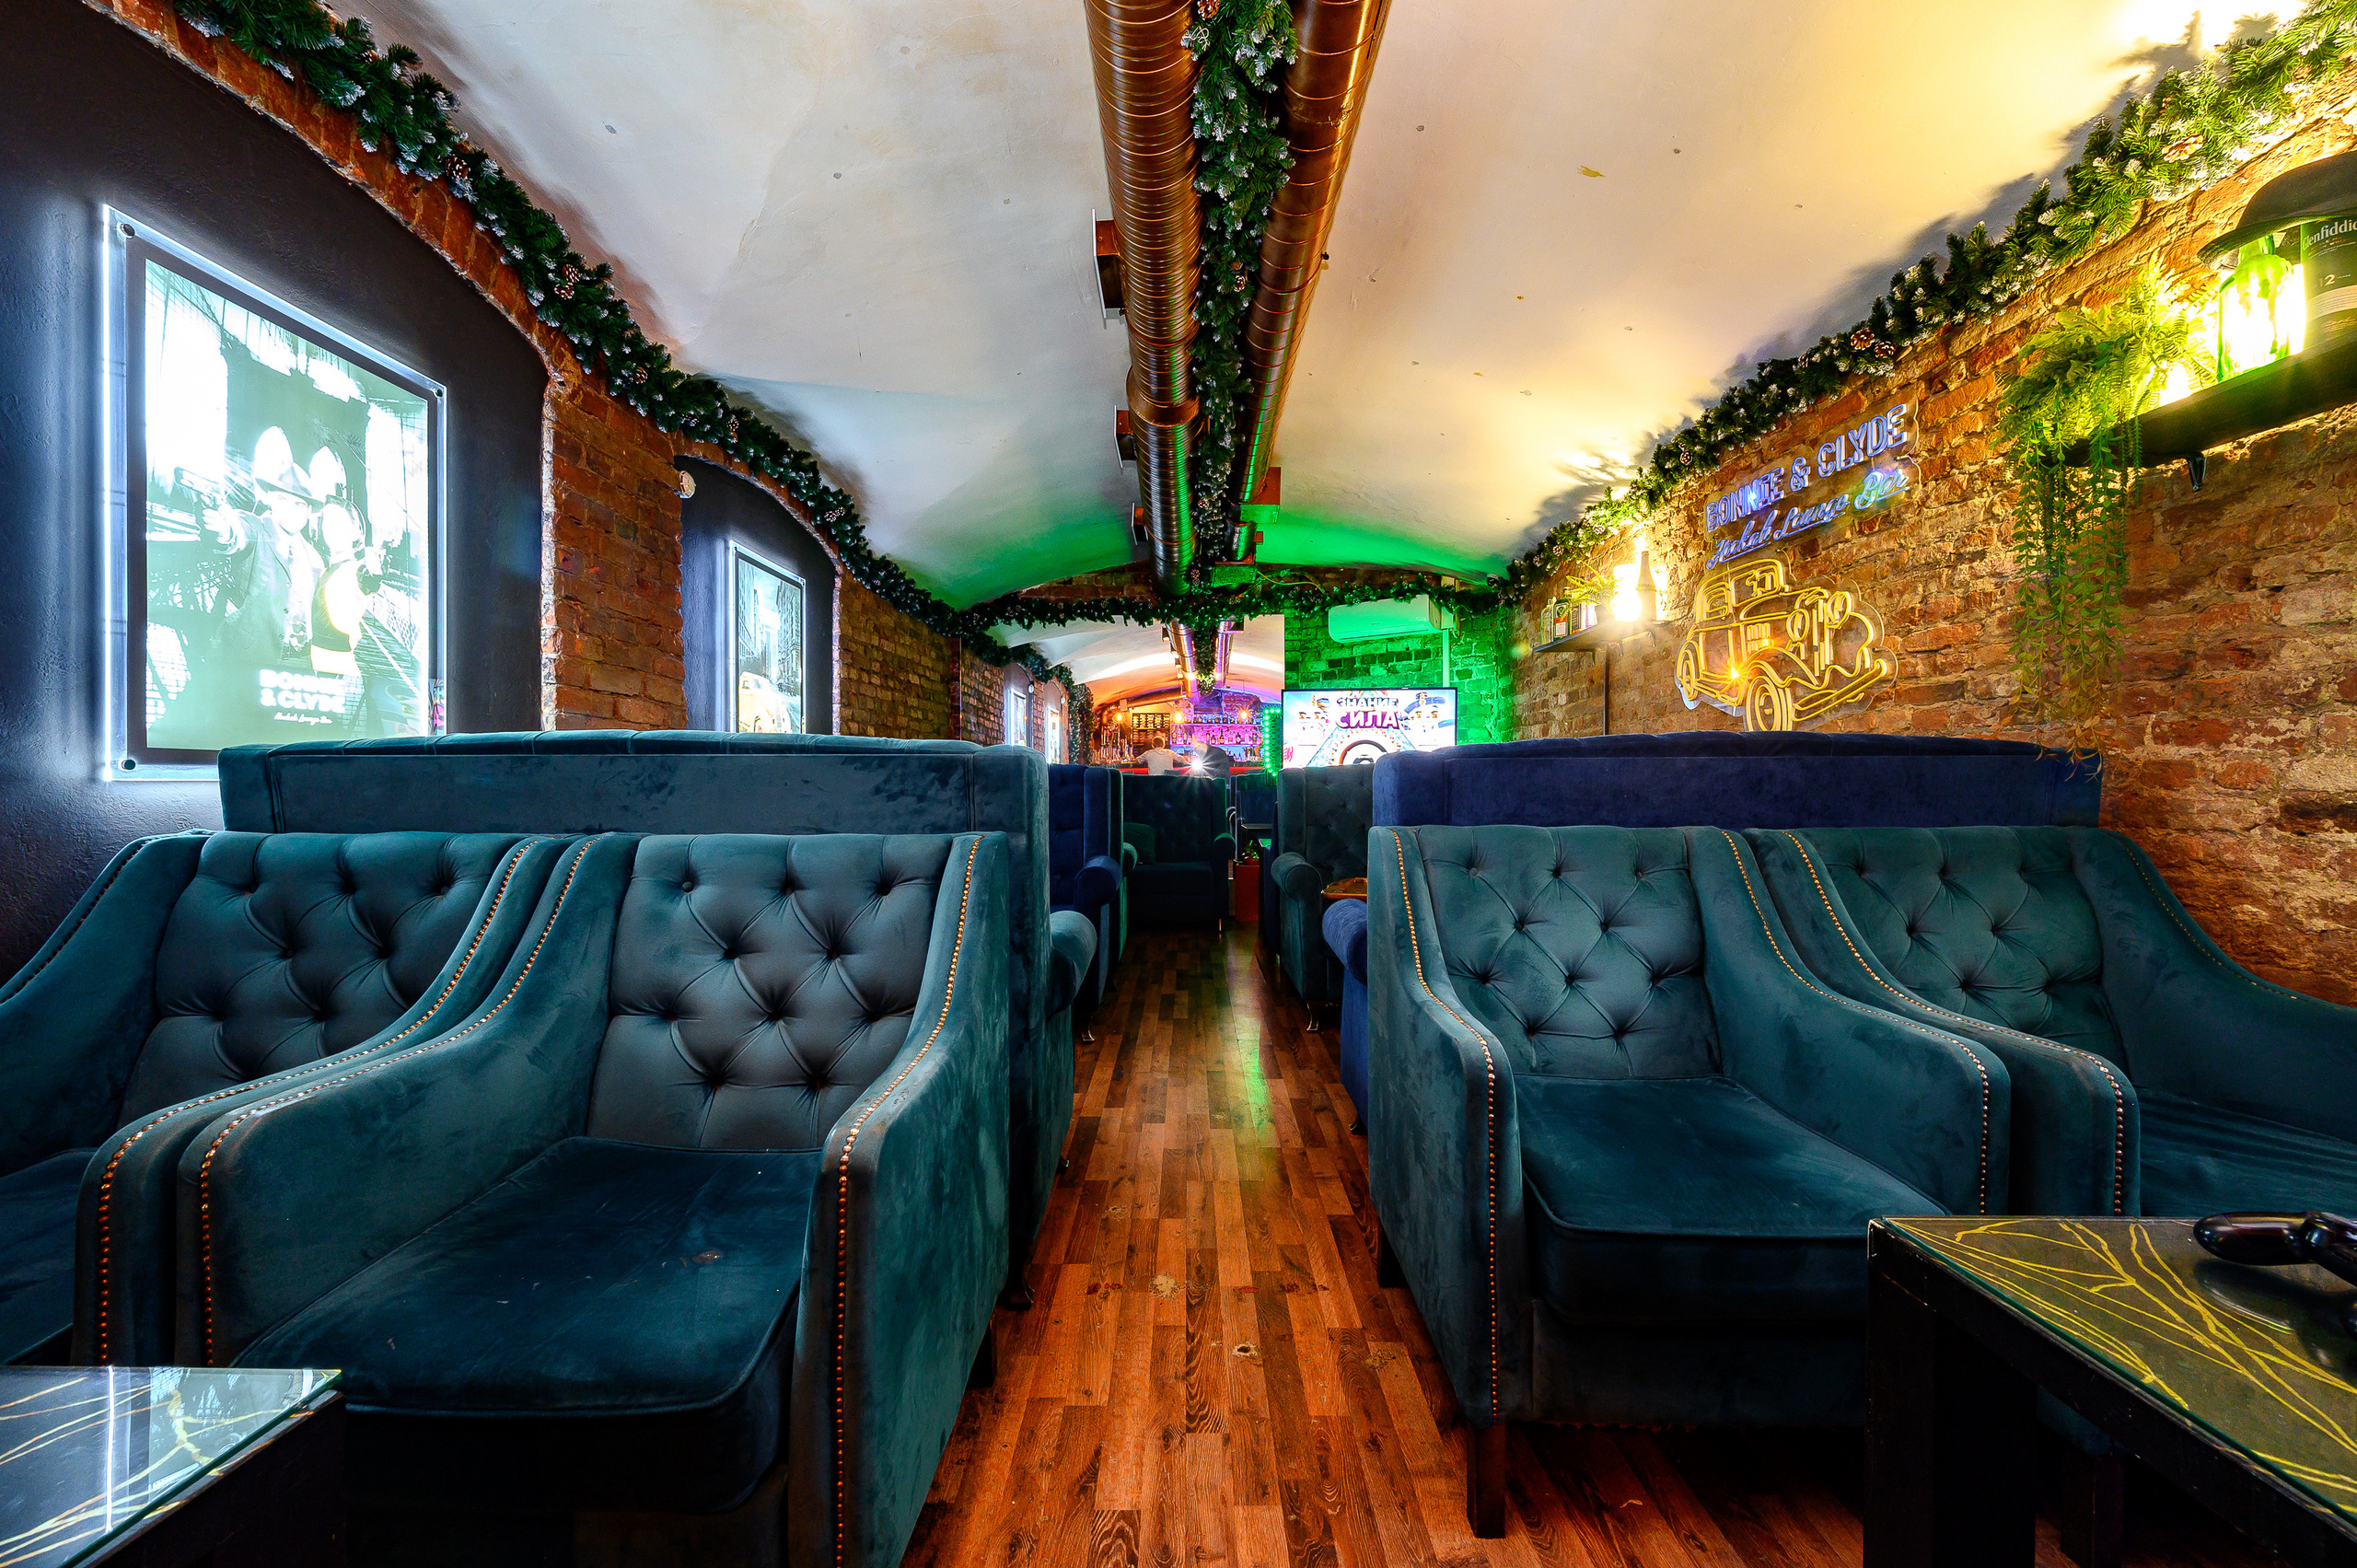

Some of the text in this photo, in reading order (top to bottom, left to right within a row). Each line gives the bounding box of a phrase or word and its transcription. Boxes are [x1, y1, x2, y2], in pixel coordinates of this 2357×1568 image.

[2302, 220, 2357, 250] Glenfiddic
[1706, 403, 1908, 532] BONNIE & CLYDE
[1706, 468, 1910, 570] Hookah Lounge Bar
[1335, 710, 1399, 729] СИЛА
